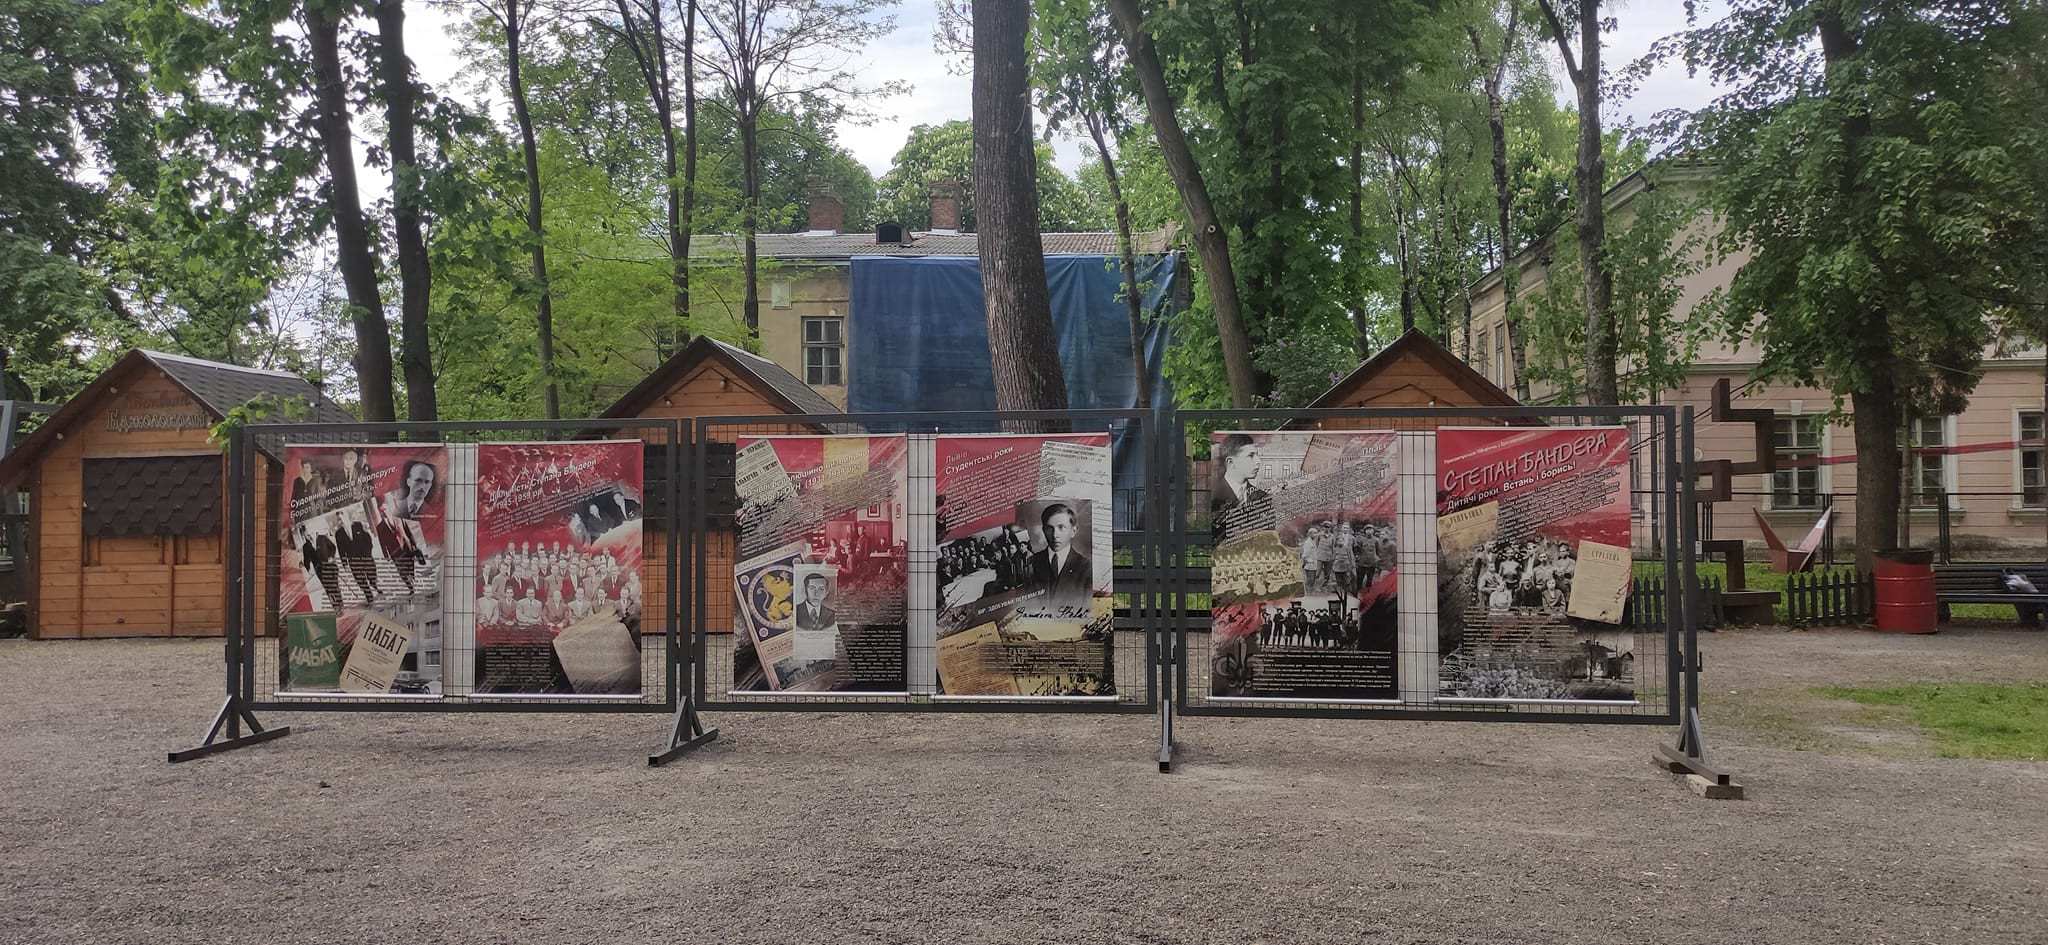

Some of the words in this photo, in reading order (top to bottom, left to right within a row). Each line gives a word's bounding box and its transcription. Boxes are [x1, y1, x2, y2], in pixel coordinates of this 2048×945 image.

[945, 454, 993, 475] Студентські
[994, 446, 1014, 460] роки
[1447, 494, 1477, 511] Дитячі
[1503, 475, 1535, 492] Встань
[1541, 461, 1577, 480] борись!
[363, 621, 408, 655] НАБАТ
[290, 644, 336, 666] НАБАТ
